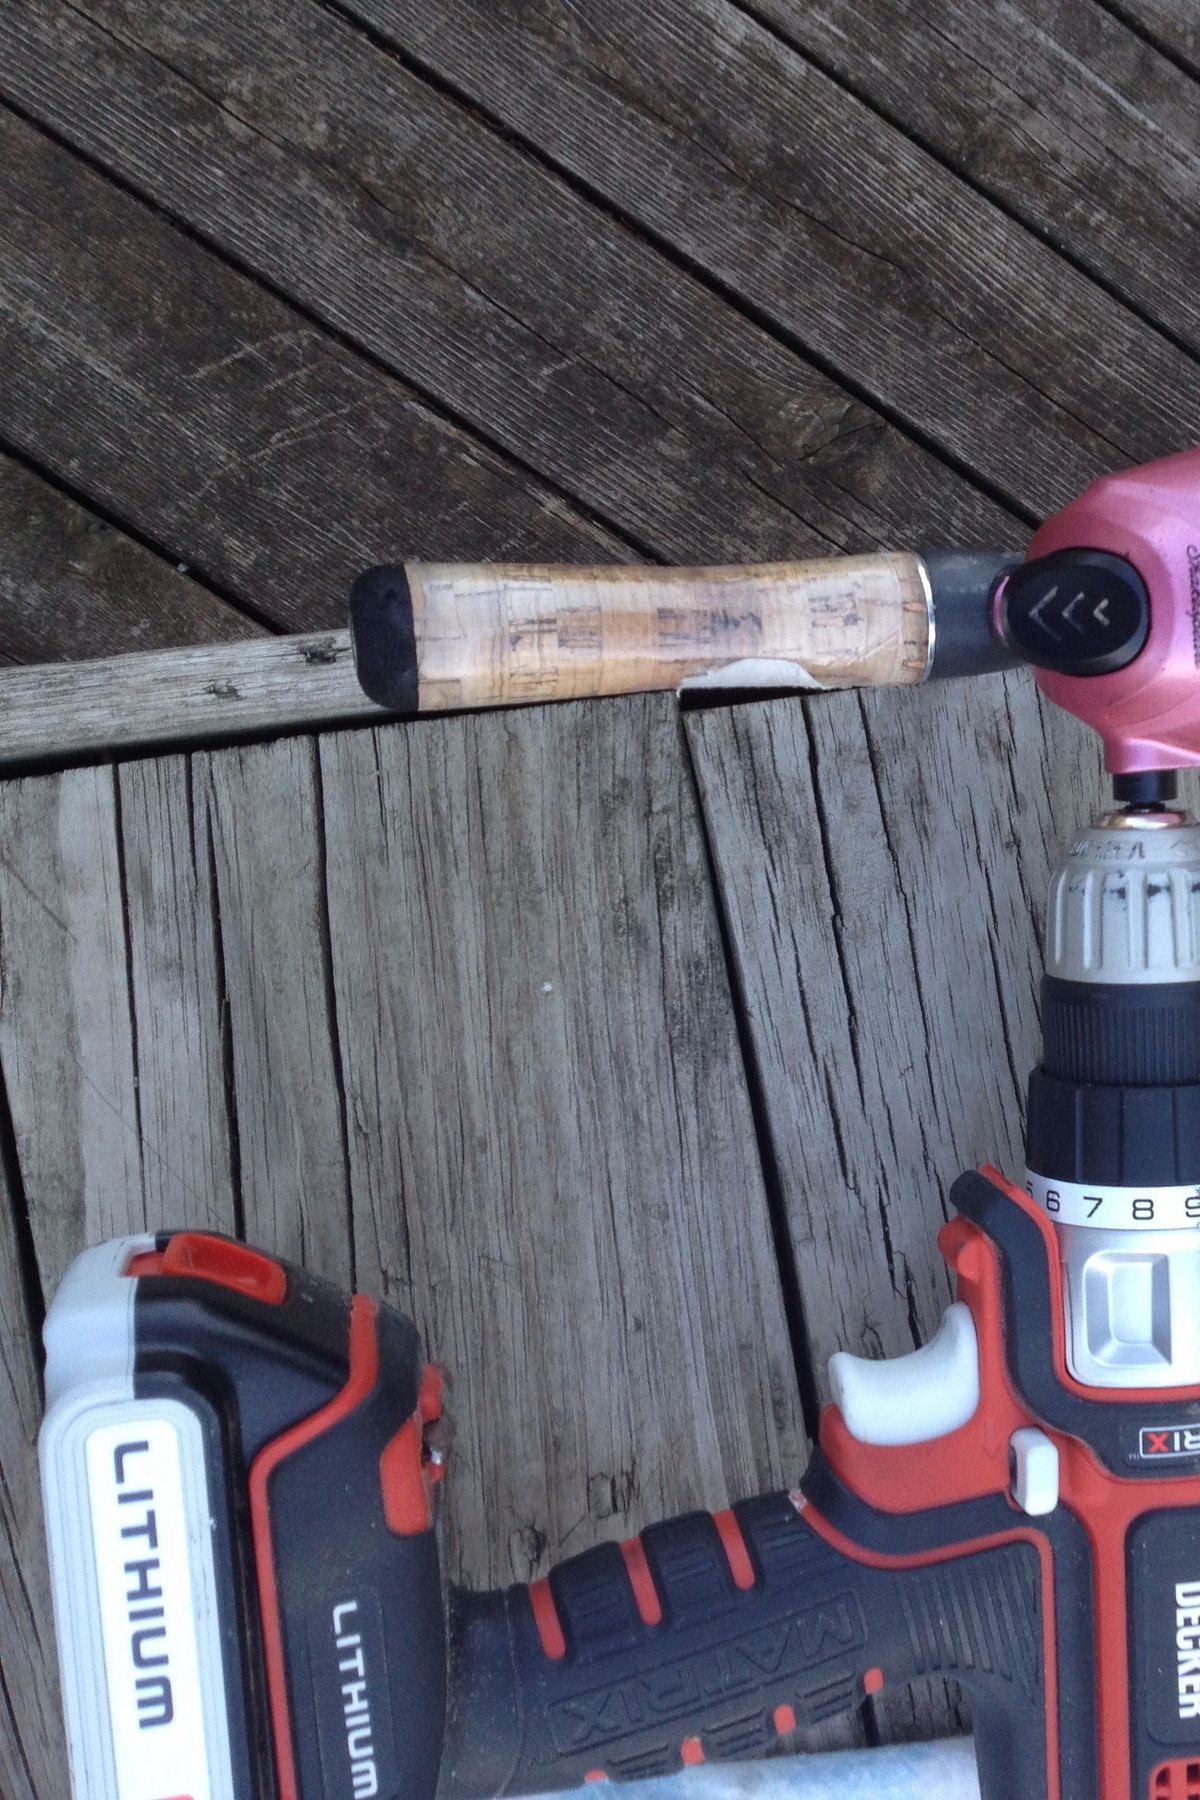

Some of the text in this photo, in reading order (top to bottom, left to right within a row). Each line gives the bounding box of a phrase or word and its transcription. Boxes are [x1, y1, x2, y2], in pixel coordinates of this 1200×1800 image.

[1046, 1190, 1060, 1212] 6
[1083, 1196, 1103, 1219] 7
[1132, 1199, 1155, 1221] 8
[113, 1440, 175, 1730] LITHIUM
[332, 1600, 379, 1800] LITHIUM
[559, 1601, 852, 1747] MATRIX
